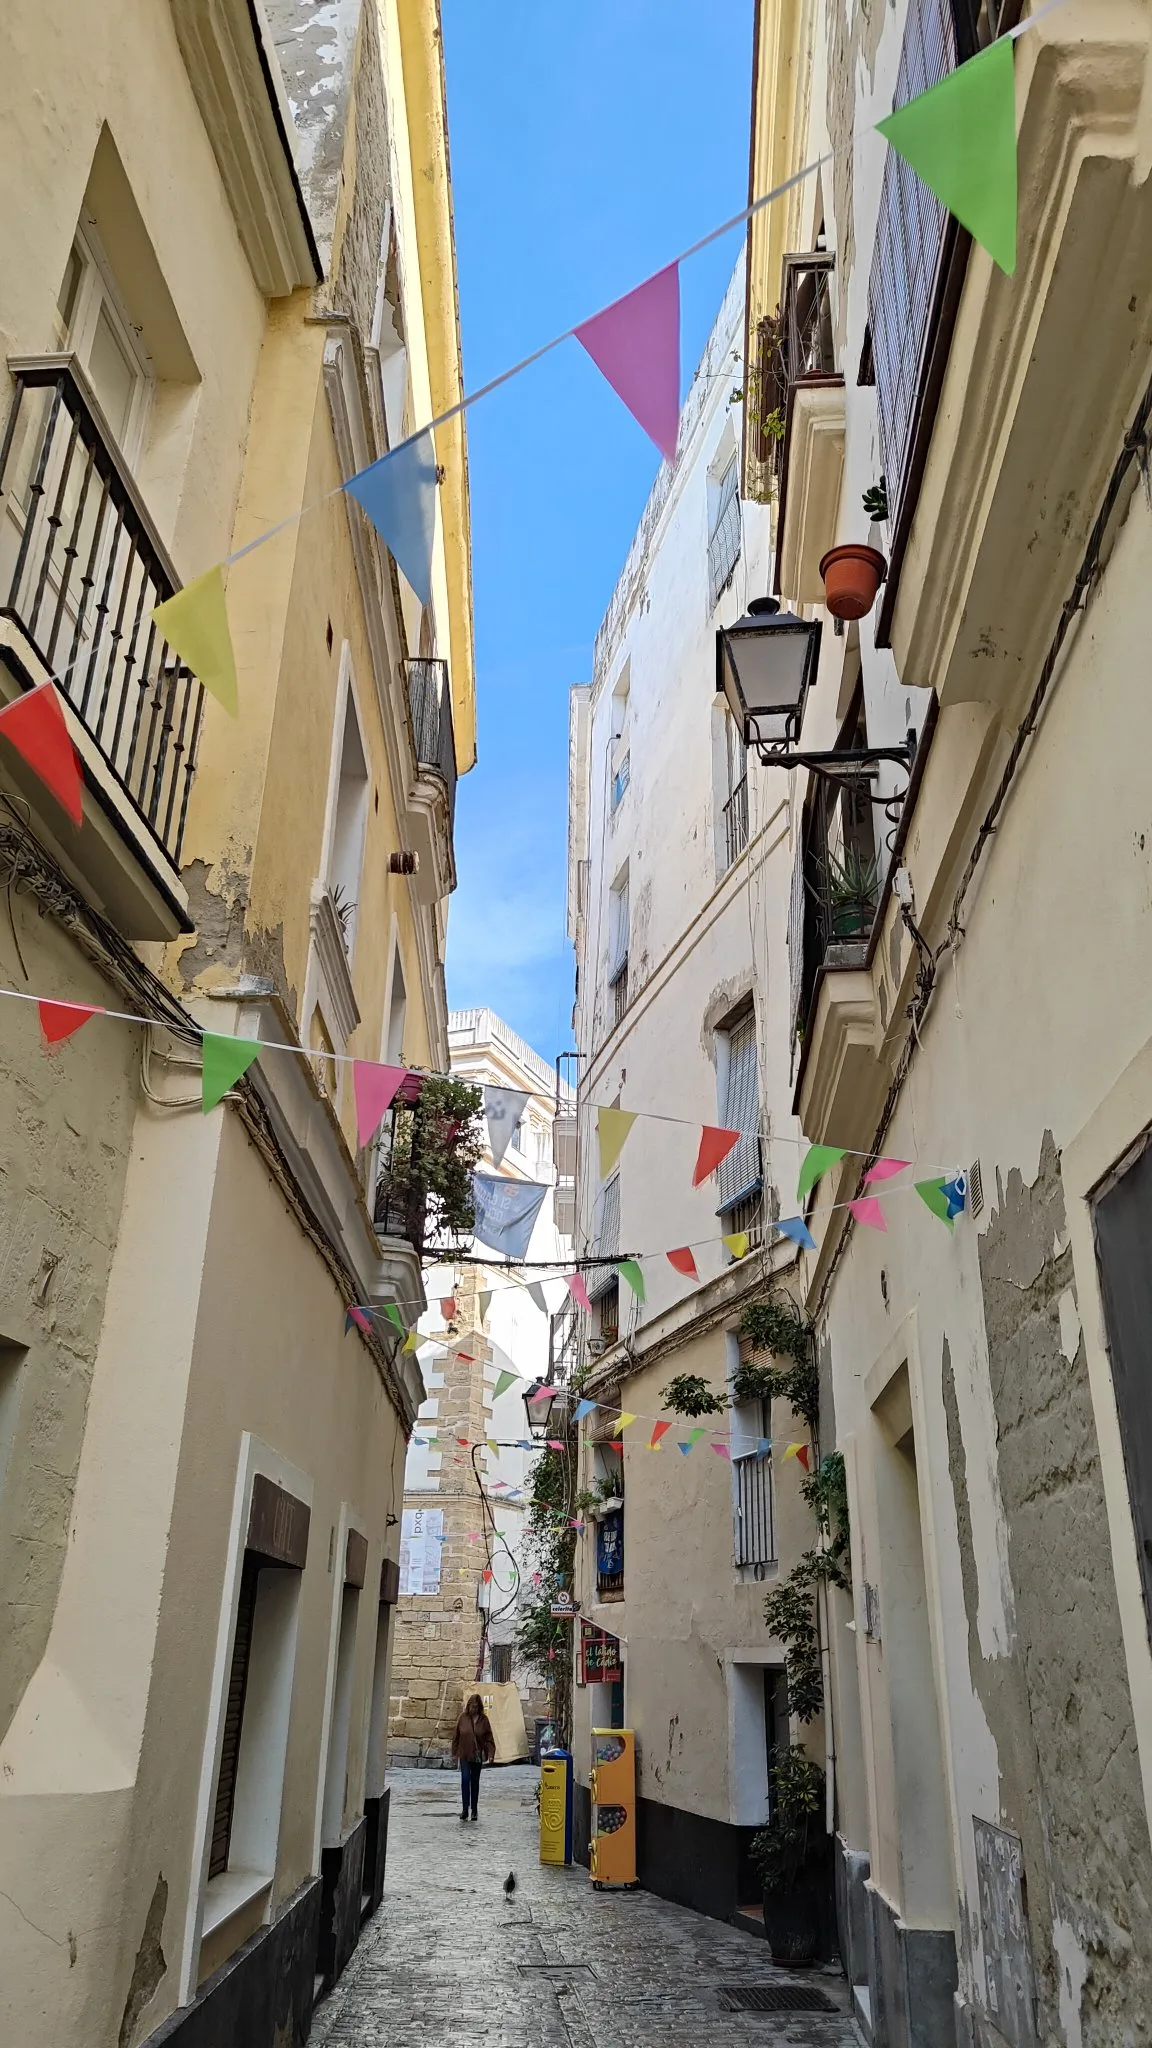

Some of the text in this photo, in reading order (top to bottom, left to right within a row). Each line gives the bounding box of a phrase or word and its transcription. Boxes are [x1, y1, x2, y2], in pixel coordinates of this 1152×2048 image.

[585, 1644, 618, 1657] el latido
[584, 1657, 594, 1667] de
